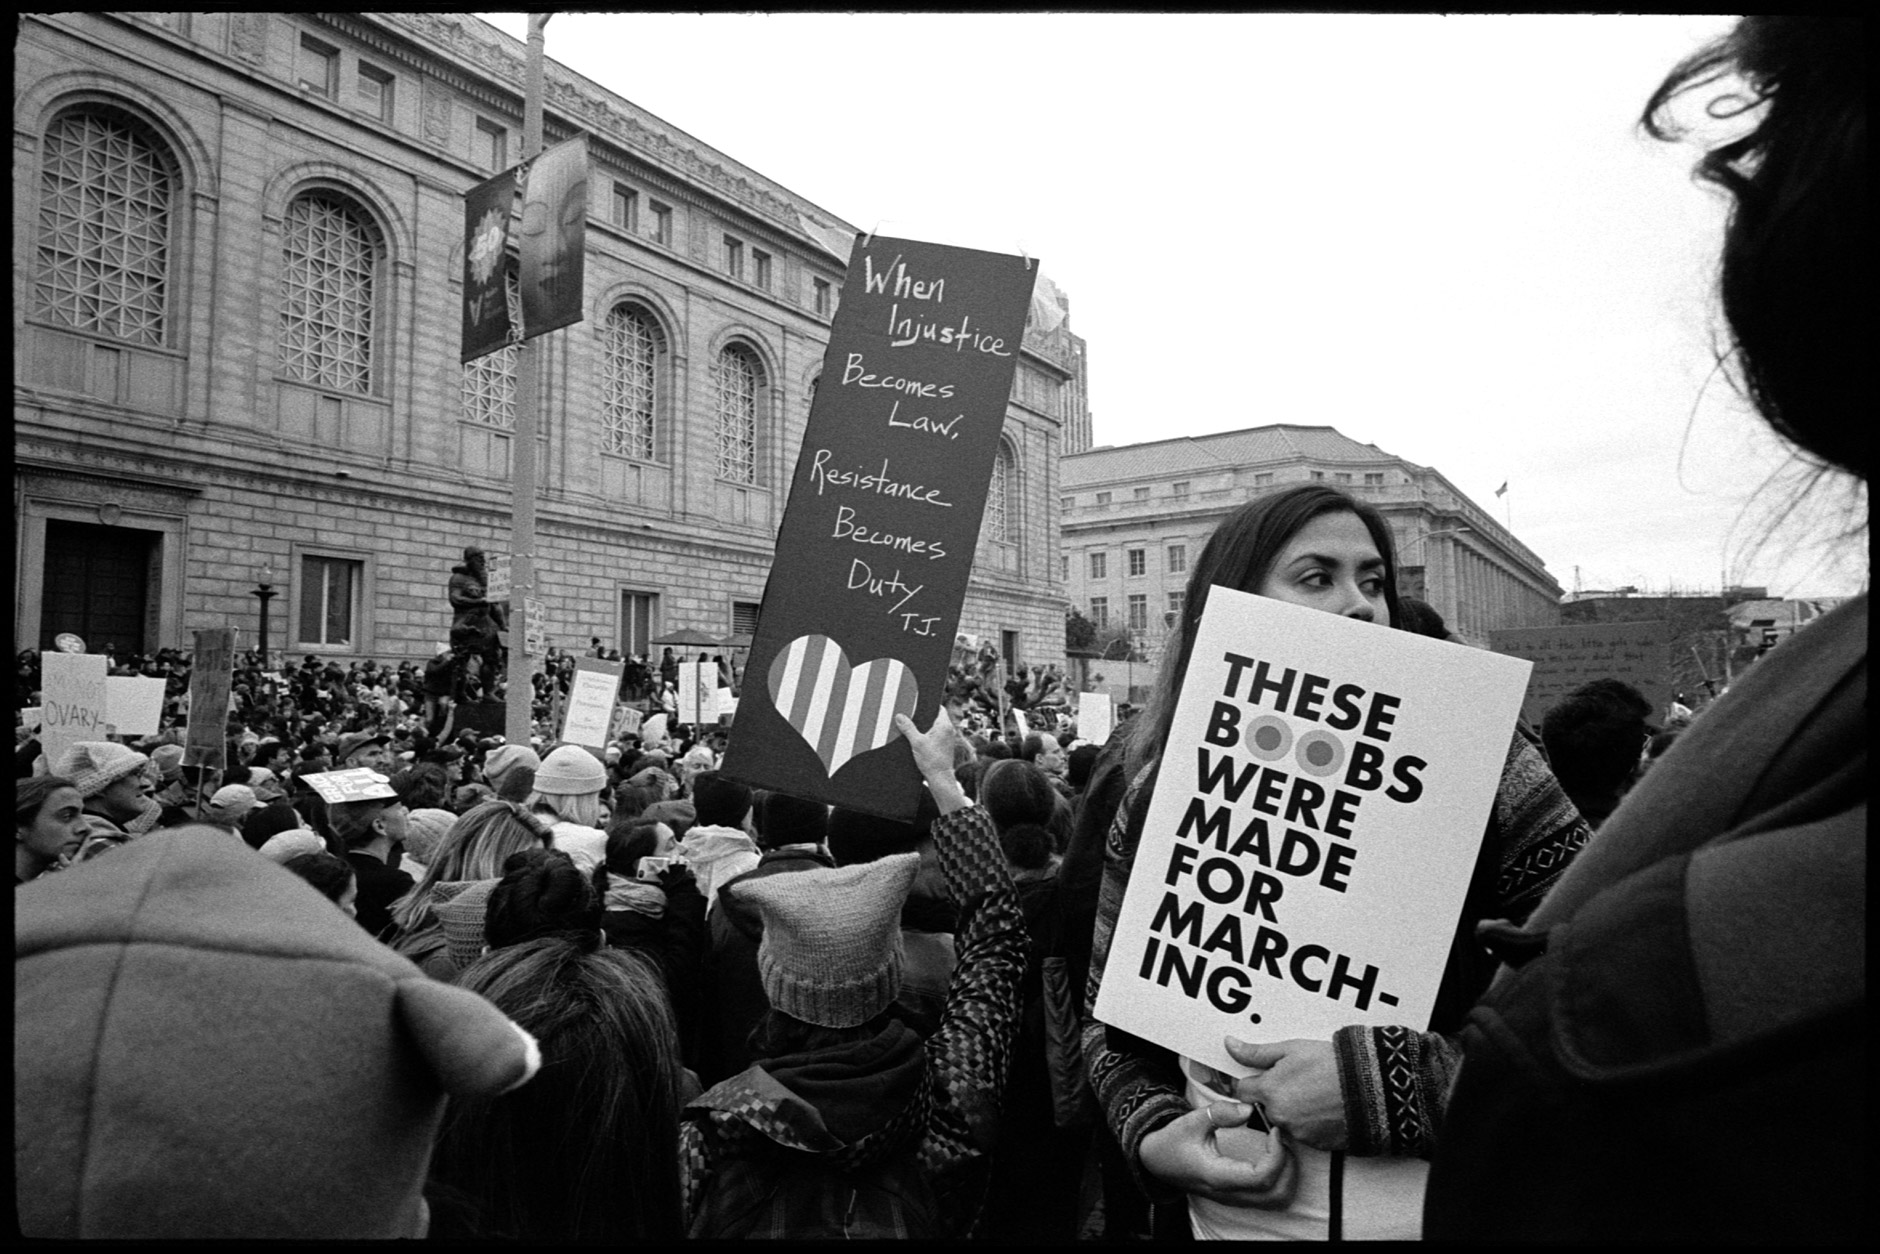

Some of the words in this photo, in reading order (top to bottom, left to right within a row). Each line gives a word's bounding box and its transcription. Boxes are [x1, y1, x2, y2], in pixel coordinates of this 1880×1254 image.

[865, 254, 944, 303] When
[888, 303, 1012, 356] Injustice
[842, 353, 955, 398] Becomes
[888, 401, 964, 440] Law,
[810, 449, 952, 507] Resistance
[832, 505, 946, 560] Becomes
[848, 558, 923, 614] Duty
[45, 700, 105, 732] OVARY-
[1224, 652, 1401, 742] THESE
[1198, 747, 1361, 840] WERE
[1176, 797, 1357, 893] MADE
[1165, 843, 1284, 924] FOR
[1139, 936, 1262, 1024] ING.
[1150, 891, 1400, 1012] MARCH-
